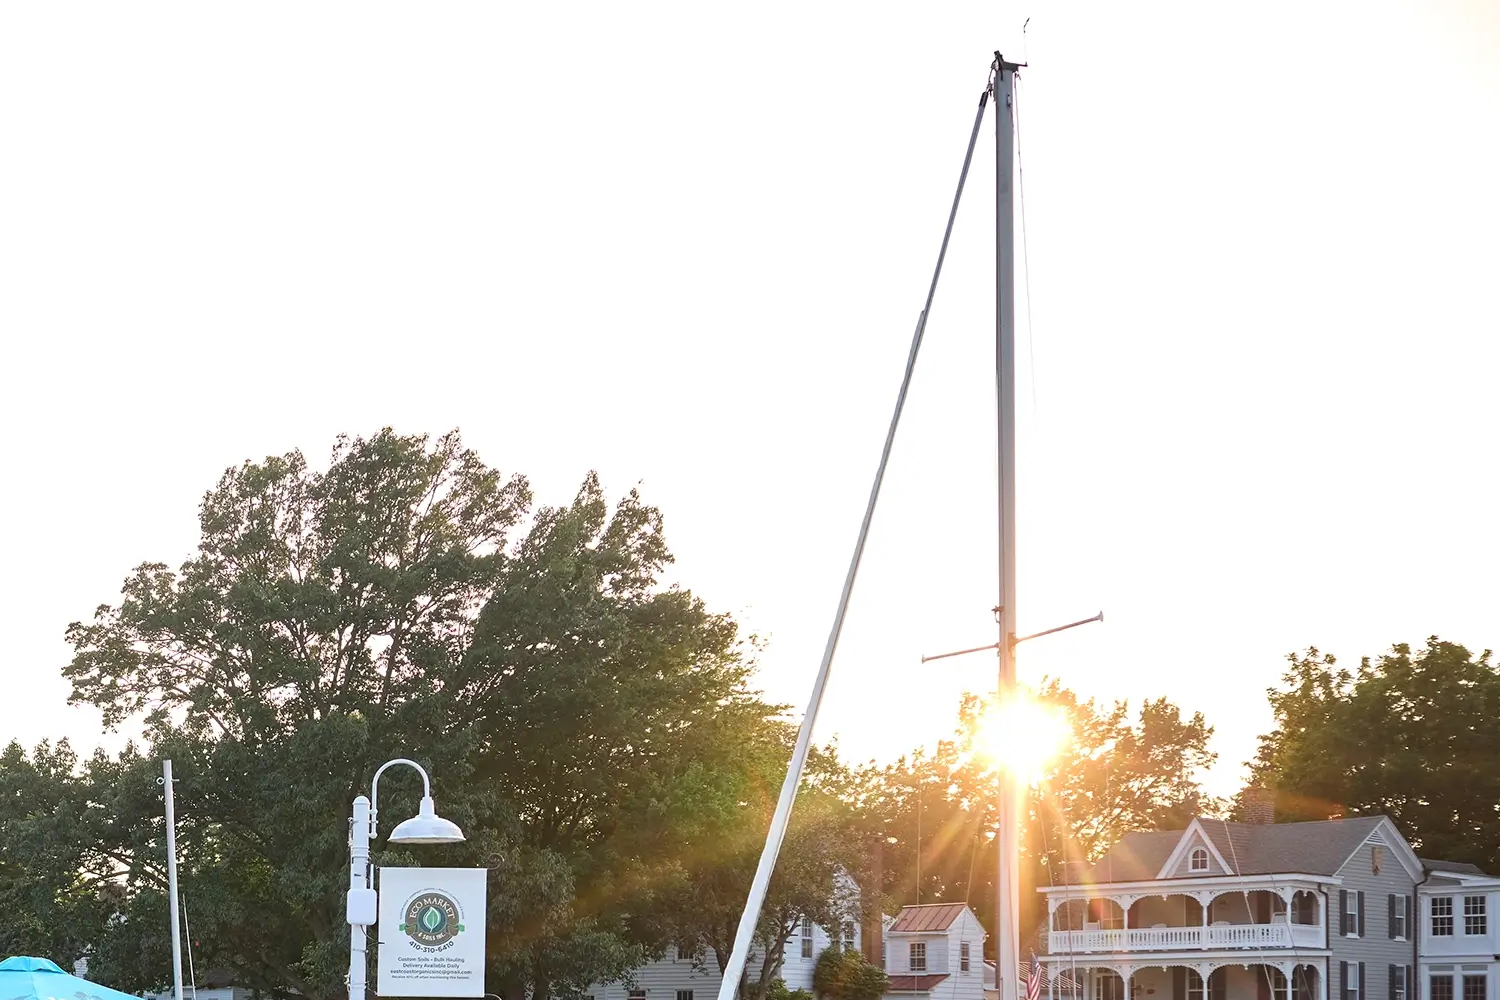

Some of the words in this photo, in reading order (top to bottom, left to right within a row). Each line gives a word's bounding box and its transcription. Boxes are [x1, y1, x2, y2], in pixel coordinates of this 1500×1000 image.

[409, 901, 423, 918] ECO
[423, 897, 456, 919] MARKET
[408, 940, 455, 953] 410-310-6410
